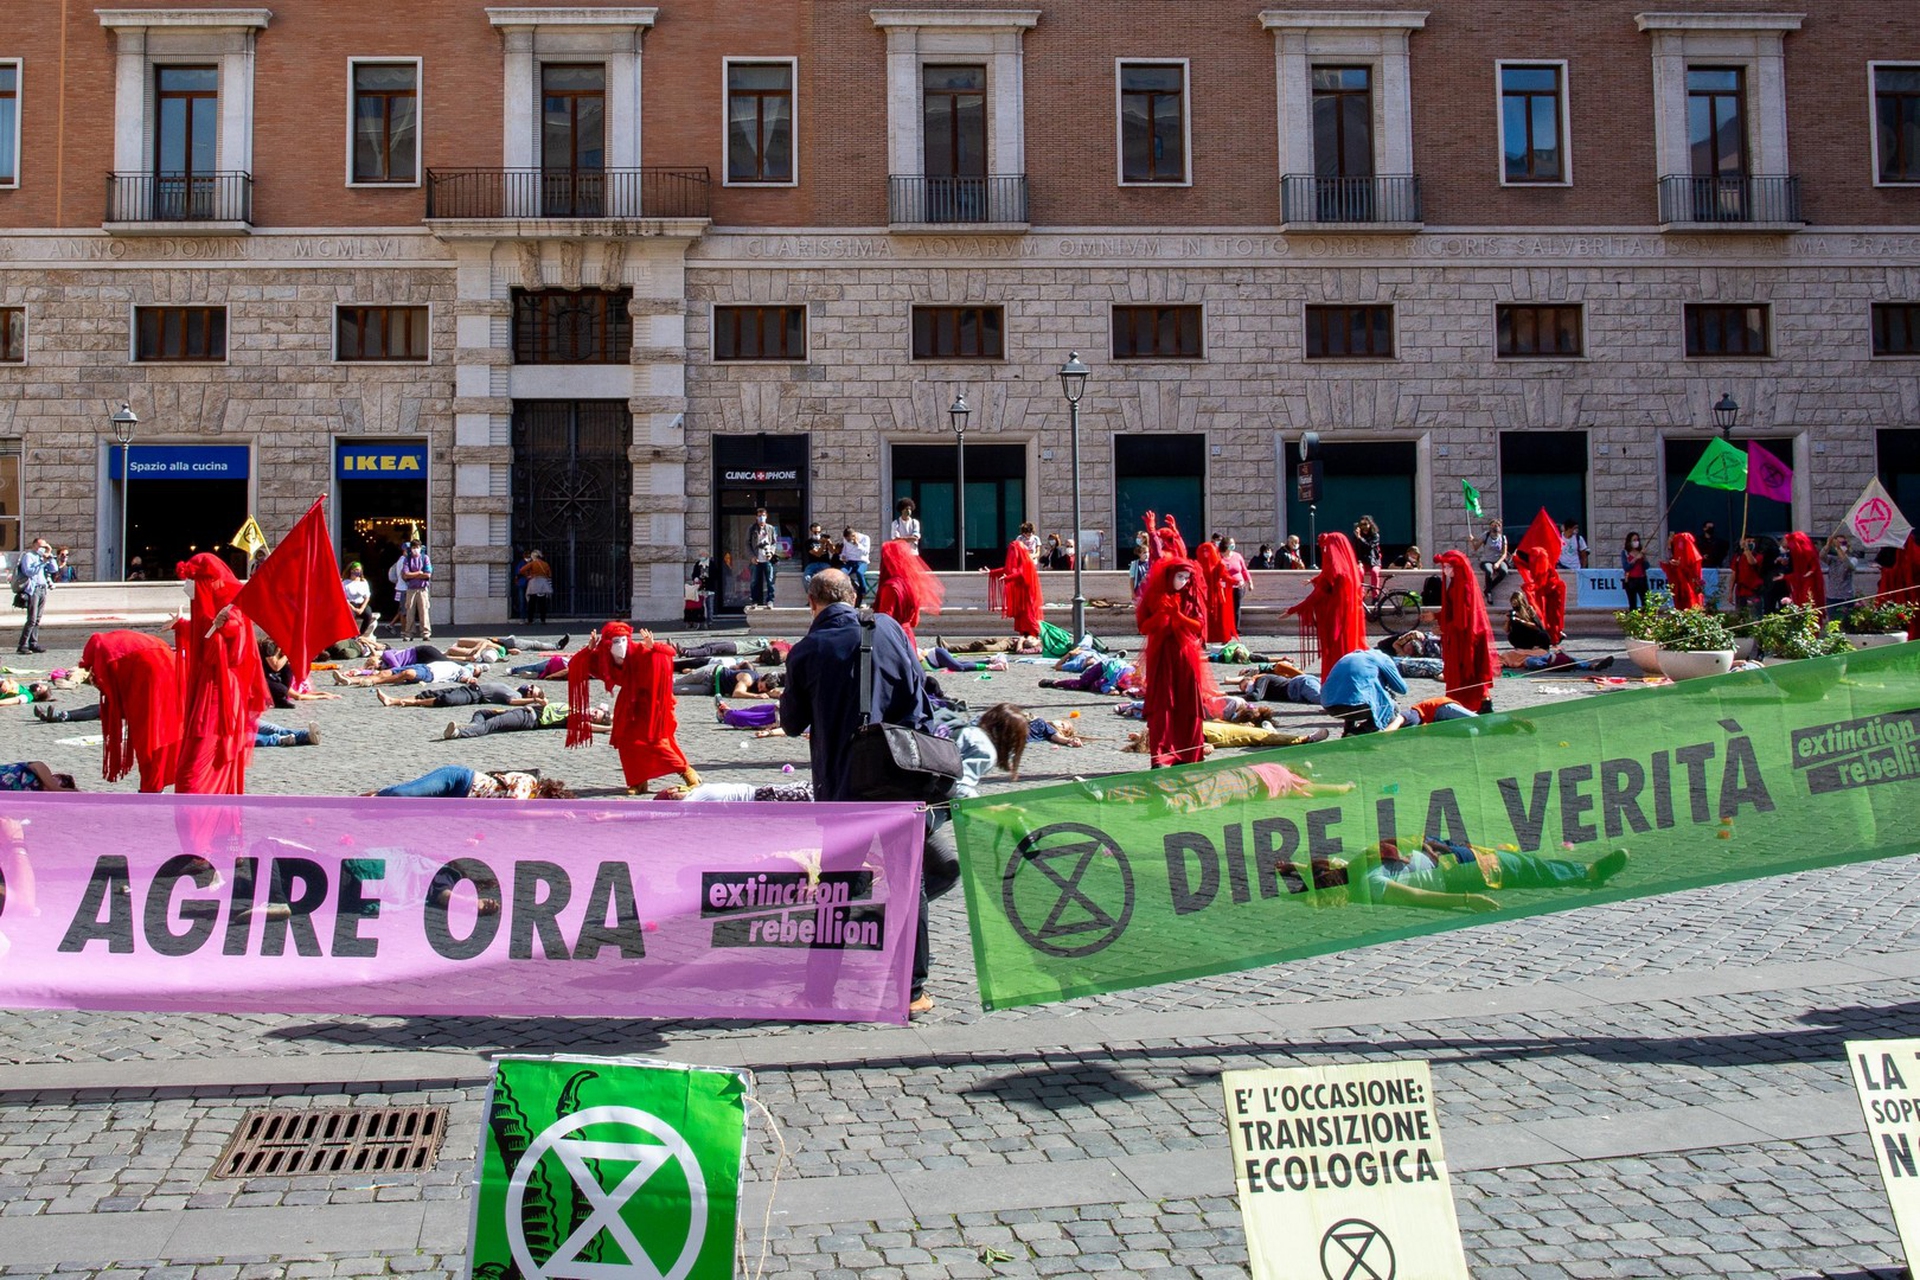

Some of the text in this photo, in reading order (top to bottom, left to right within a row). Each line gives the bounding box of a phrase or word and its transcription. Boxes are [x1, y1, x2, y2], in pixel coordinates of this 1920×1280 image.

[49, 240, 127, 259] ANNO
[294, 239, 404, 258] MCMLVI
[747, 238, 894, 257] CLARISSIMA
[912, 237, 1038, 257] AQVARVM
[1058, 238, 1162, 256] OMNIVM
[1180, 238, 1200, 256] IN
[1218, 237, 1290, 256] TOTO
[1751, 237, 1829, 256] PALMA
[130, 461, 228, 473] Spazio alla cucina
[343, 455, 419, 470] IKEA
[725, 470, 797, 480] CLINICA IPHONE
[1590, 578, 1617, 590] TELL
[1797, 716, 1916, 758] extinction
[1837, 744, 1920, 784] rebelli
[1163, 806, 1349, 916] DIRE
[1497, 718, 1776, 852] VERITÀ
[57, 854, 386, 958] AGIRE
[424, 857, 646, 961] ORA
[709, 873, 850, 908] extinction
[749, 902, 878, 945] rebellion
[1858, 1052, 1907, 1091] LA
[1235, 1078, 1425, 1114] E' L'OCCASIONE:
[1239, 1110, 1431, 1151] TRANSIZIONE
[1246, 1148, 1439, 1193] ECOLOGICA
[1881, 1133, 1920, 1178] N
